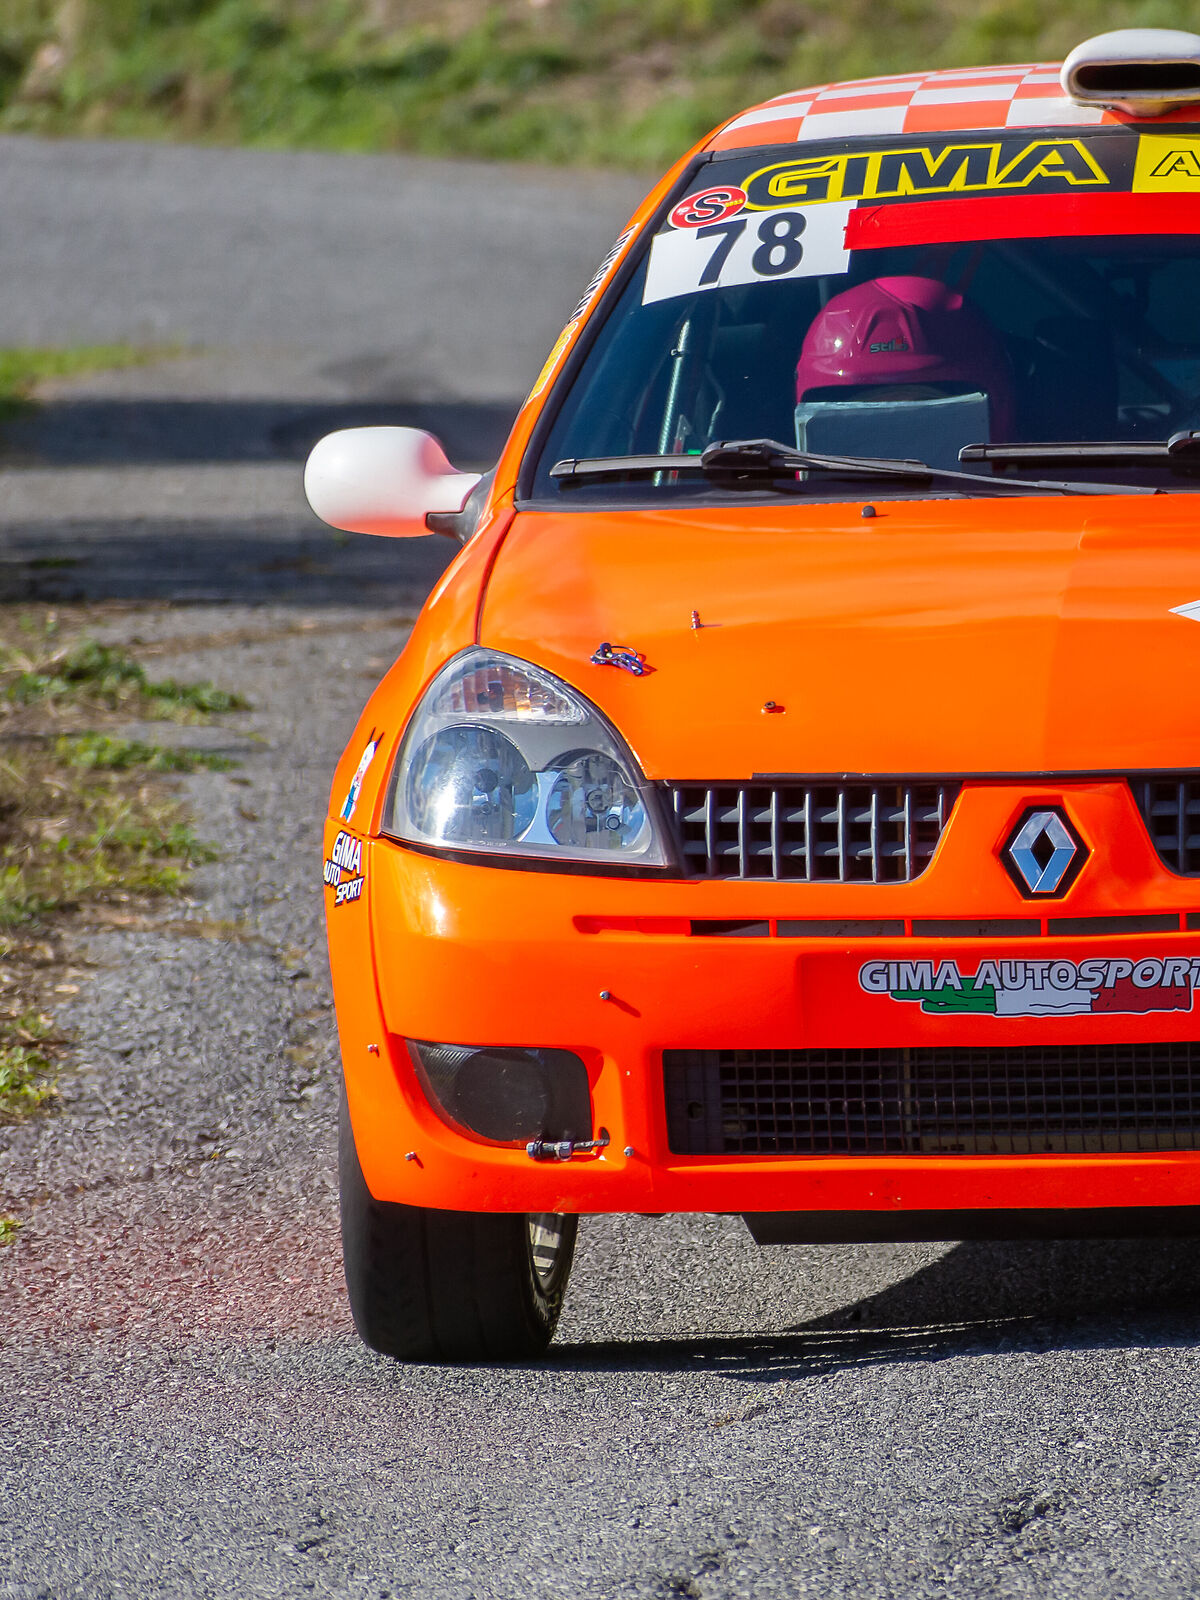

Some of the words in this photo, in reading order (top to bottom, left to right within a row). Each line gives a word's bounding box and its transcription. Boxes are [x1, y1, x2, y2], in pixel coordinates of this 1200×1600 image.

[740, 138, 1111, 212] GIMA
[696, 211, 806, 286] 78
[332, 830, 363, 874] GIMA
[336, 877, 364, 903] SPORT
[860, 960, 962, 992] GIMA
